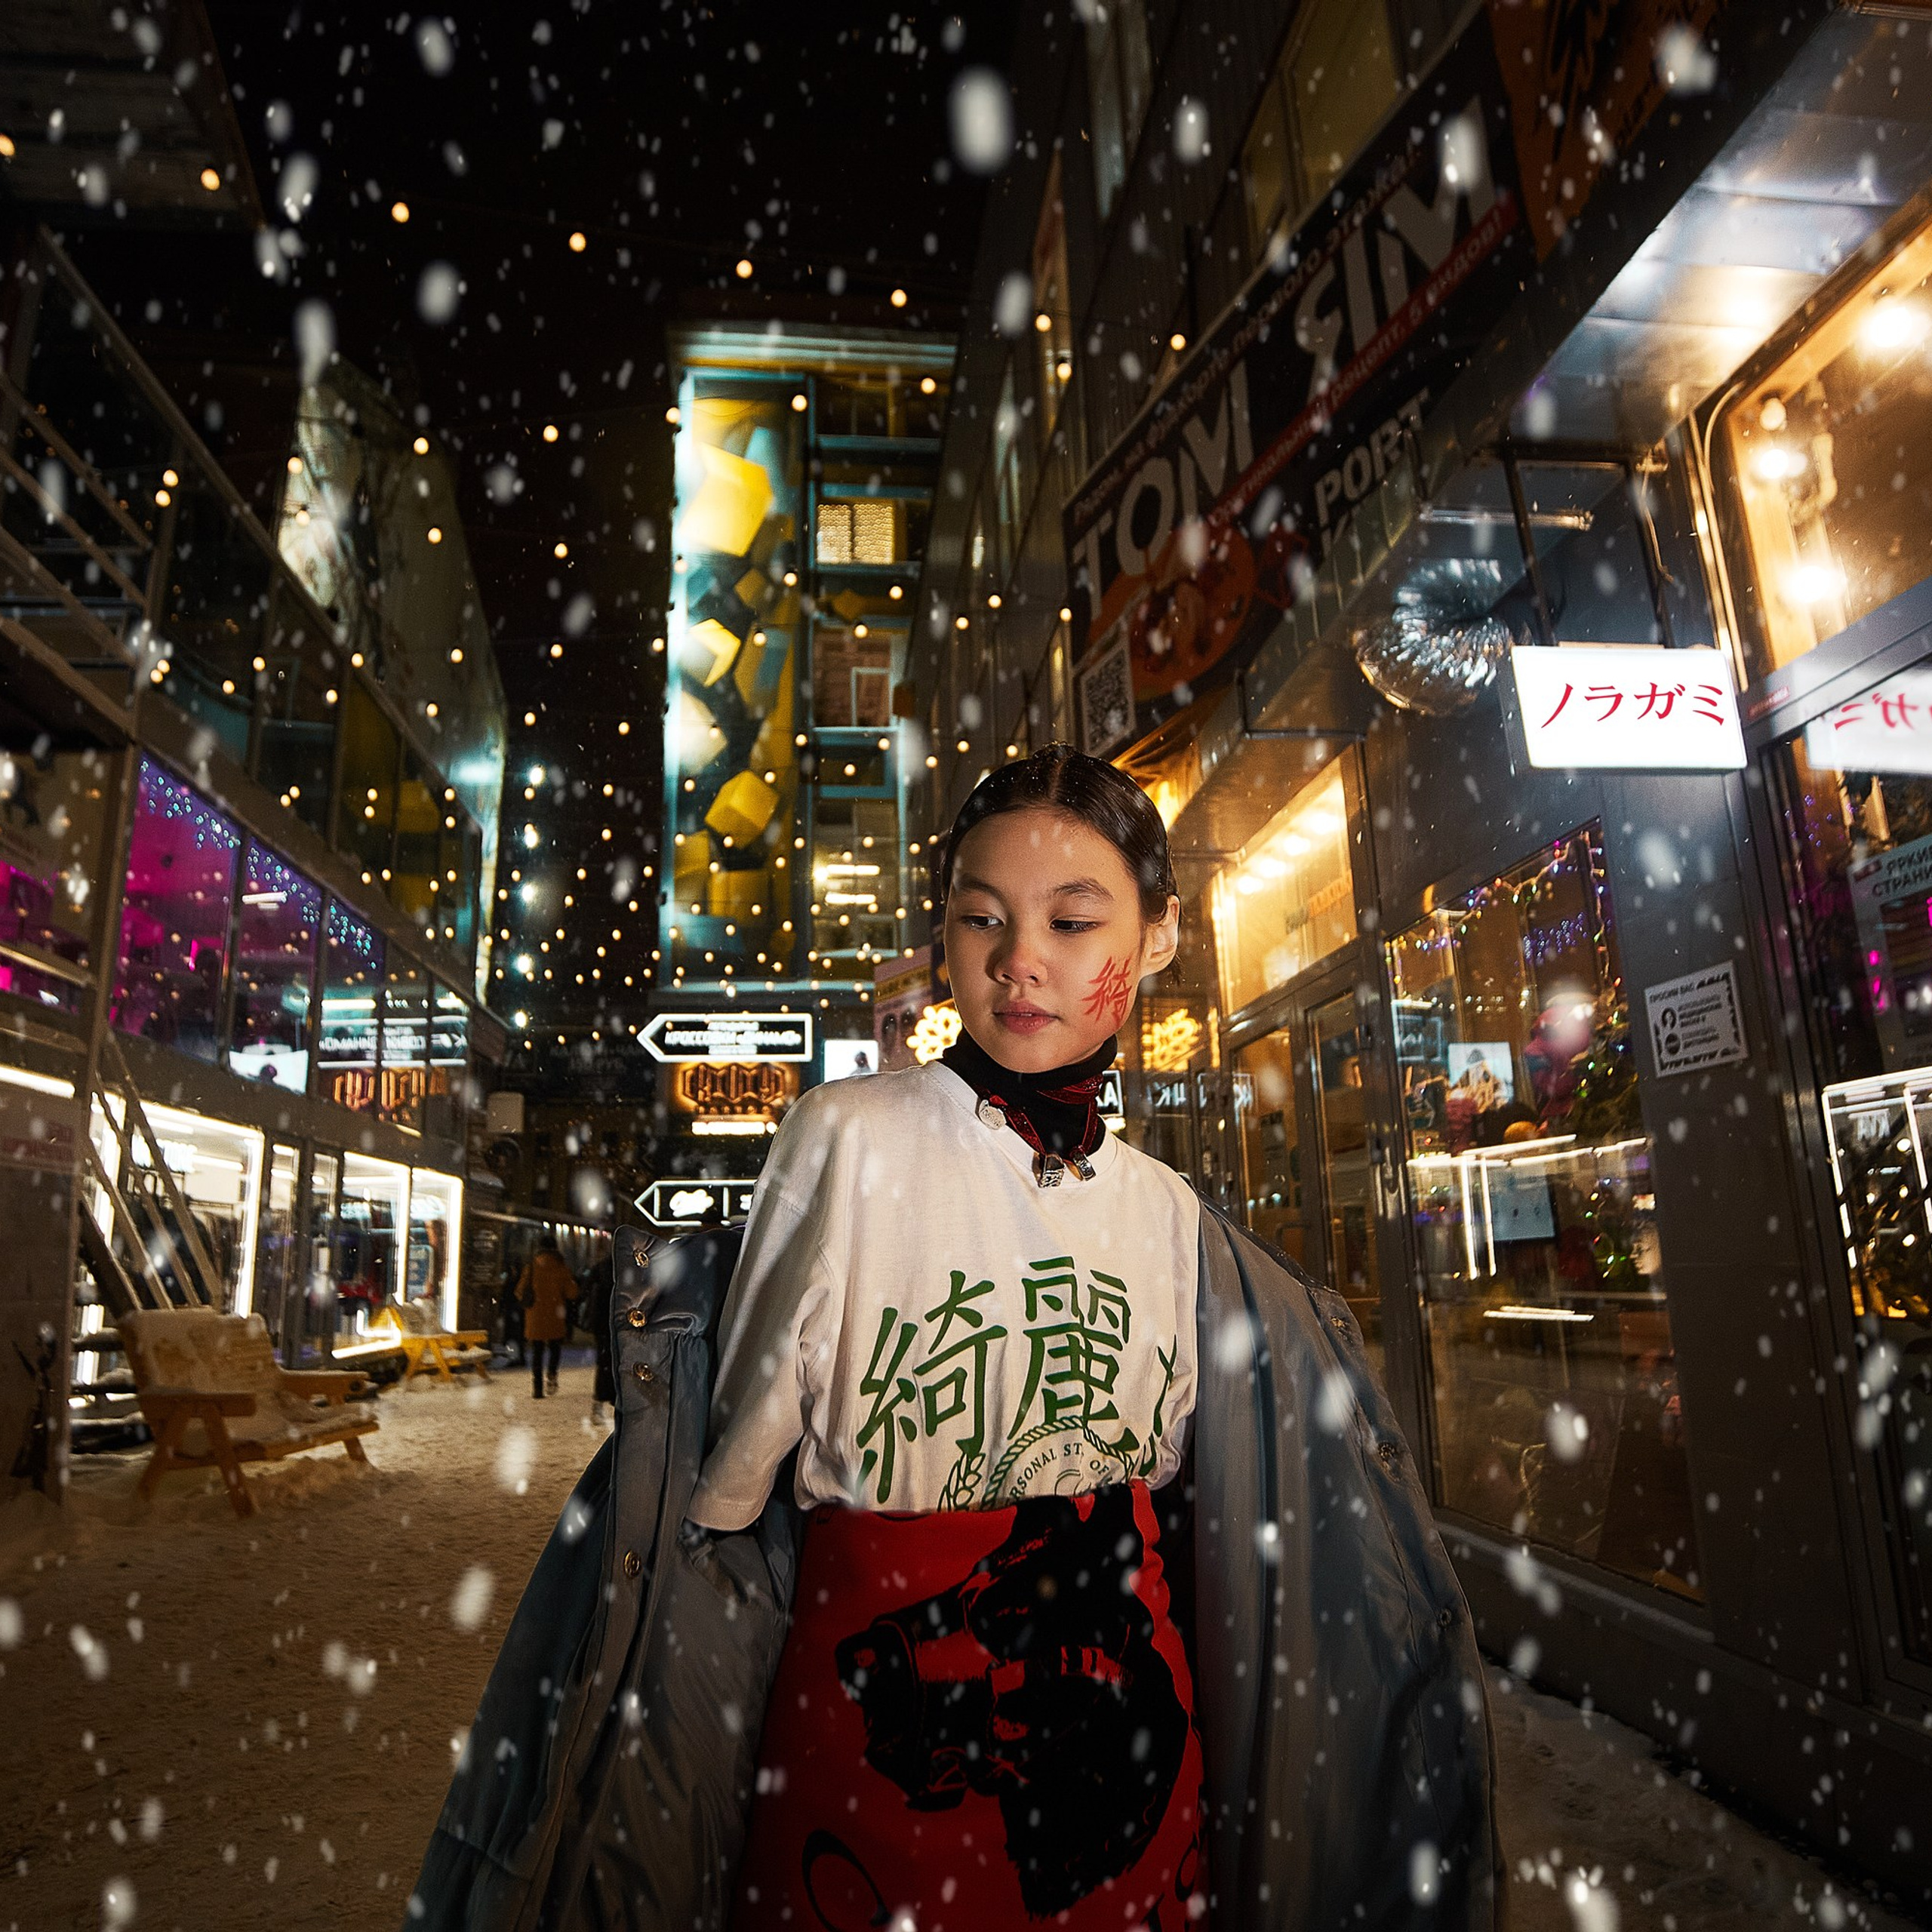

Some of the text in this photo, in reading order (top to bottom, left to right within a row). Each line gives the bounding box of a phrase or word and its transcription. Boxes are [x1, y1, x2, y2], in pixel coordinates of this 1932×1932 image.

[1315, 386, 1431, 528] PORT
[1541, 681, 1724, 729] ノラガミ
